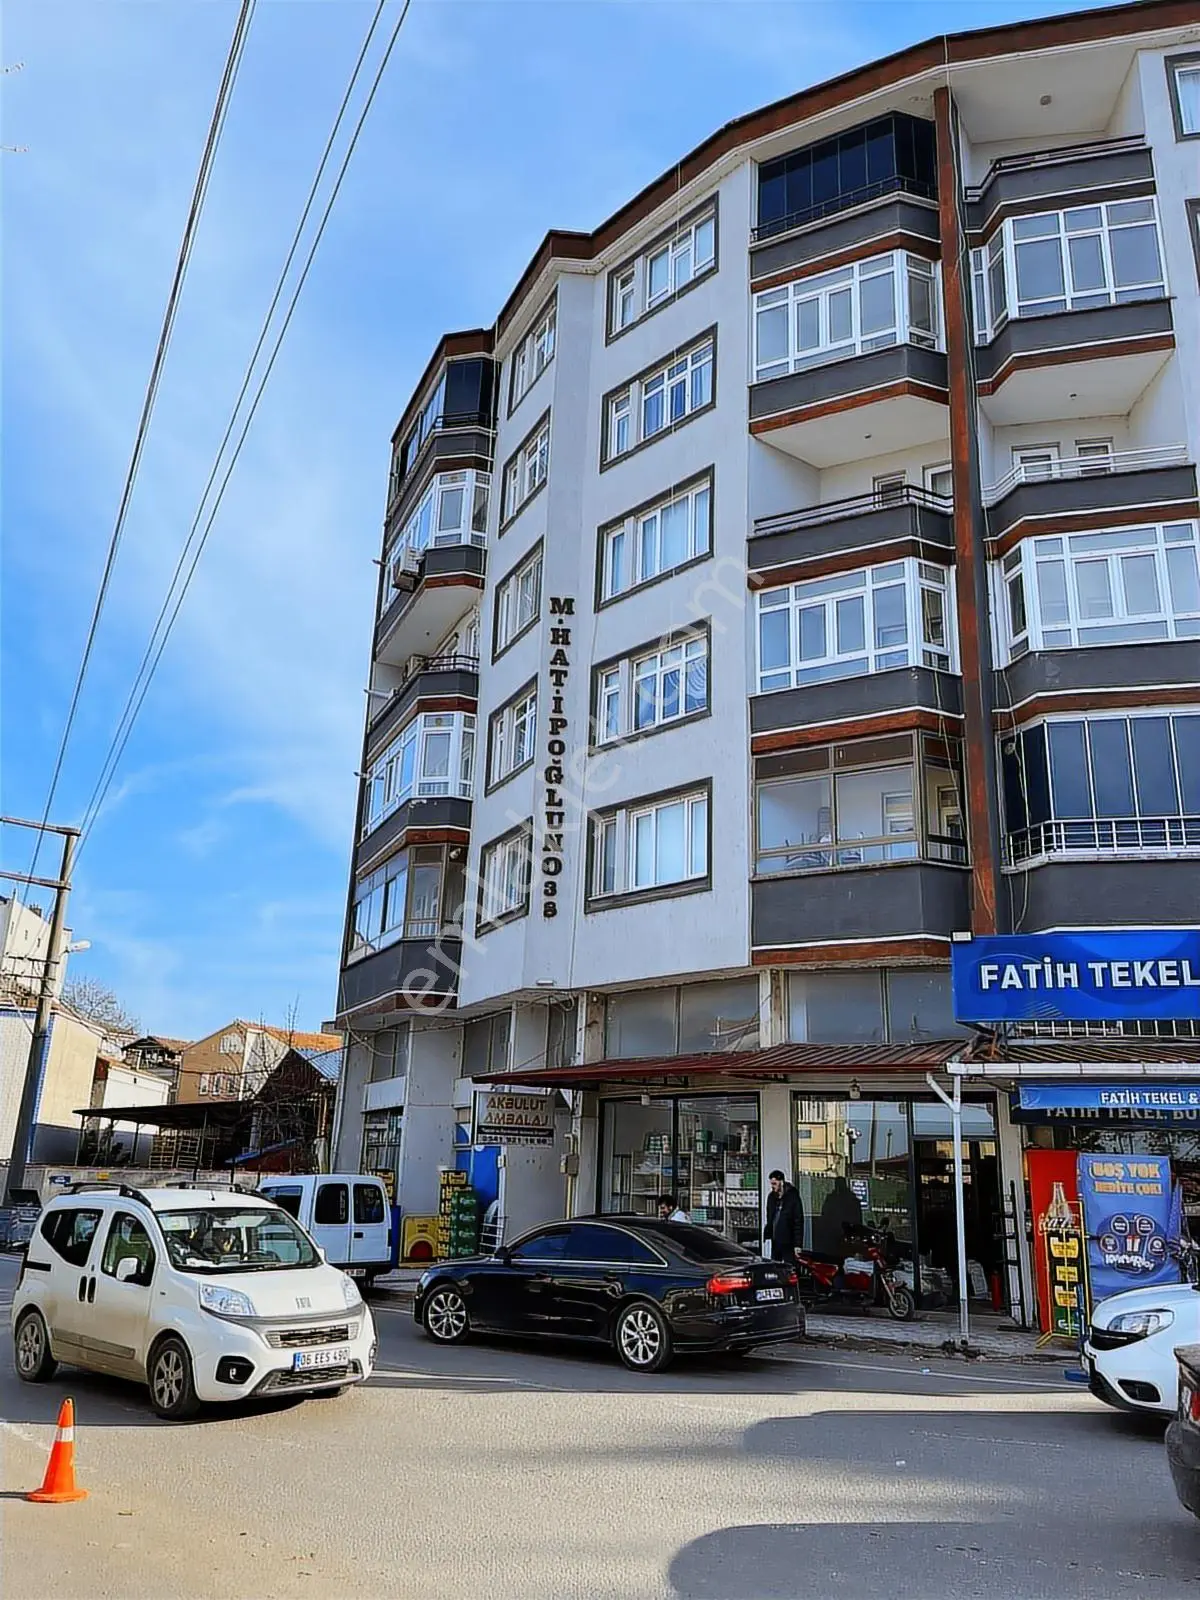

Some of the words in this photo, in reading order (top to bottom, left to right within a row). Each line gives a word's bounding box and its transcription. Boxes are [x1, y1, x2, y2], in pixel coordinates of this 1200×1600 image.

[980, 956, 1079, 990] FATİH
[1087, 959, 1200, 988] TEKEL
[486, 1096, 547, 1111] AKBULUT
[1101, 1089, 1140, 1105] FATİH
[1143, 1091, 1186, 1105] TEKEL
[484, 1111, 549, 1127] AMBALAJ
